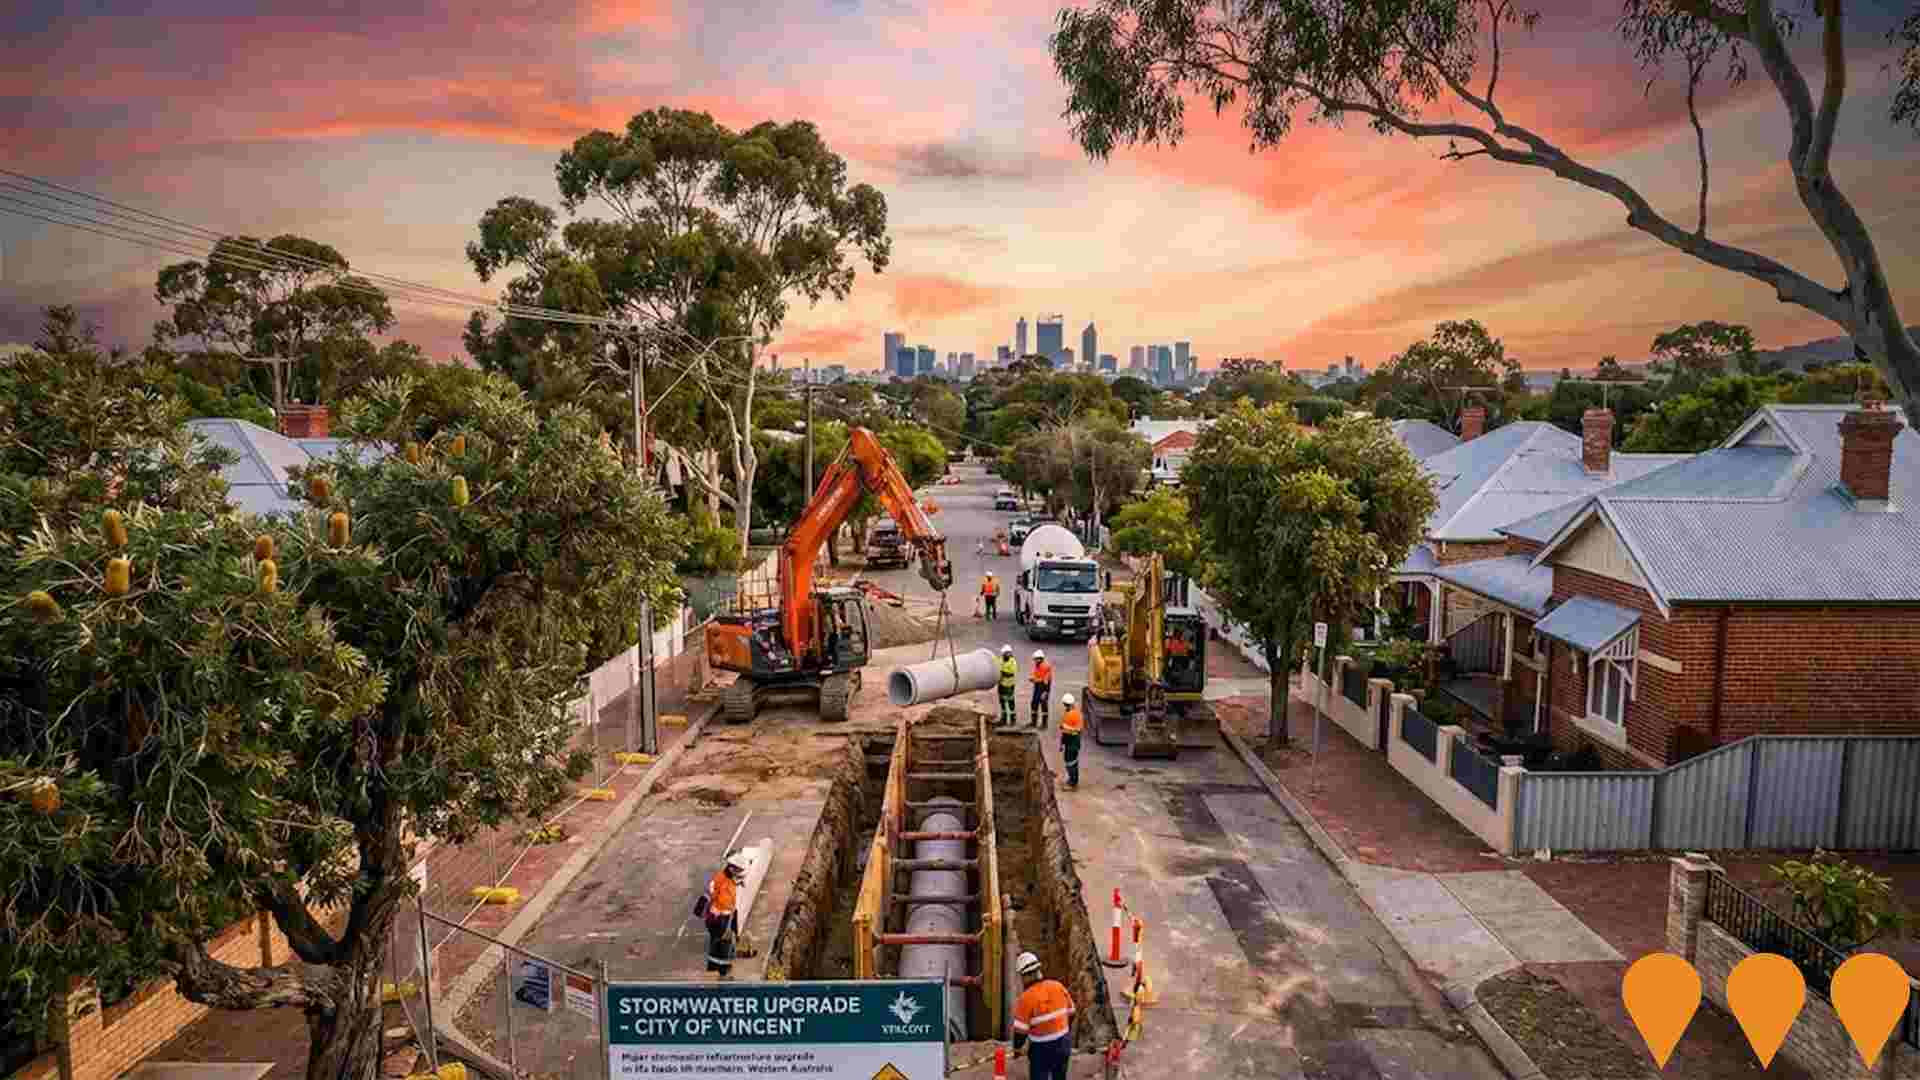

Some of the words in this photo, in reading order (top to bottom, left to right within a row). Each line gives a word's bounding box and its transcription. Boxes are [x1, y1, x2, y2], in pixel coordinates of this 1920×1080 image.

[619, 997, 758, 1014] STORMWATER
[764, 997, 861, 1014] UPGRADE
[635, 1018, 680, 1035] CITY
[685, 1018, 712, 1035] OF
[717, 1018, 805, 1035] VINCENT
